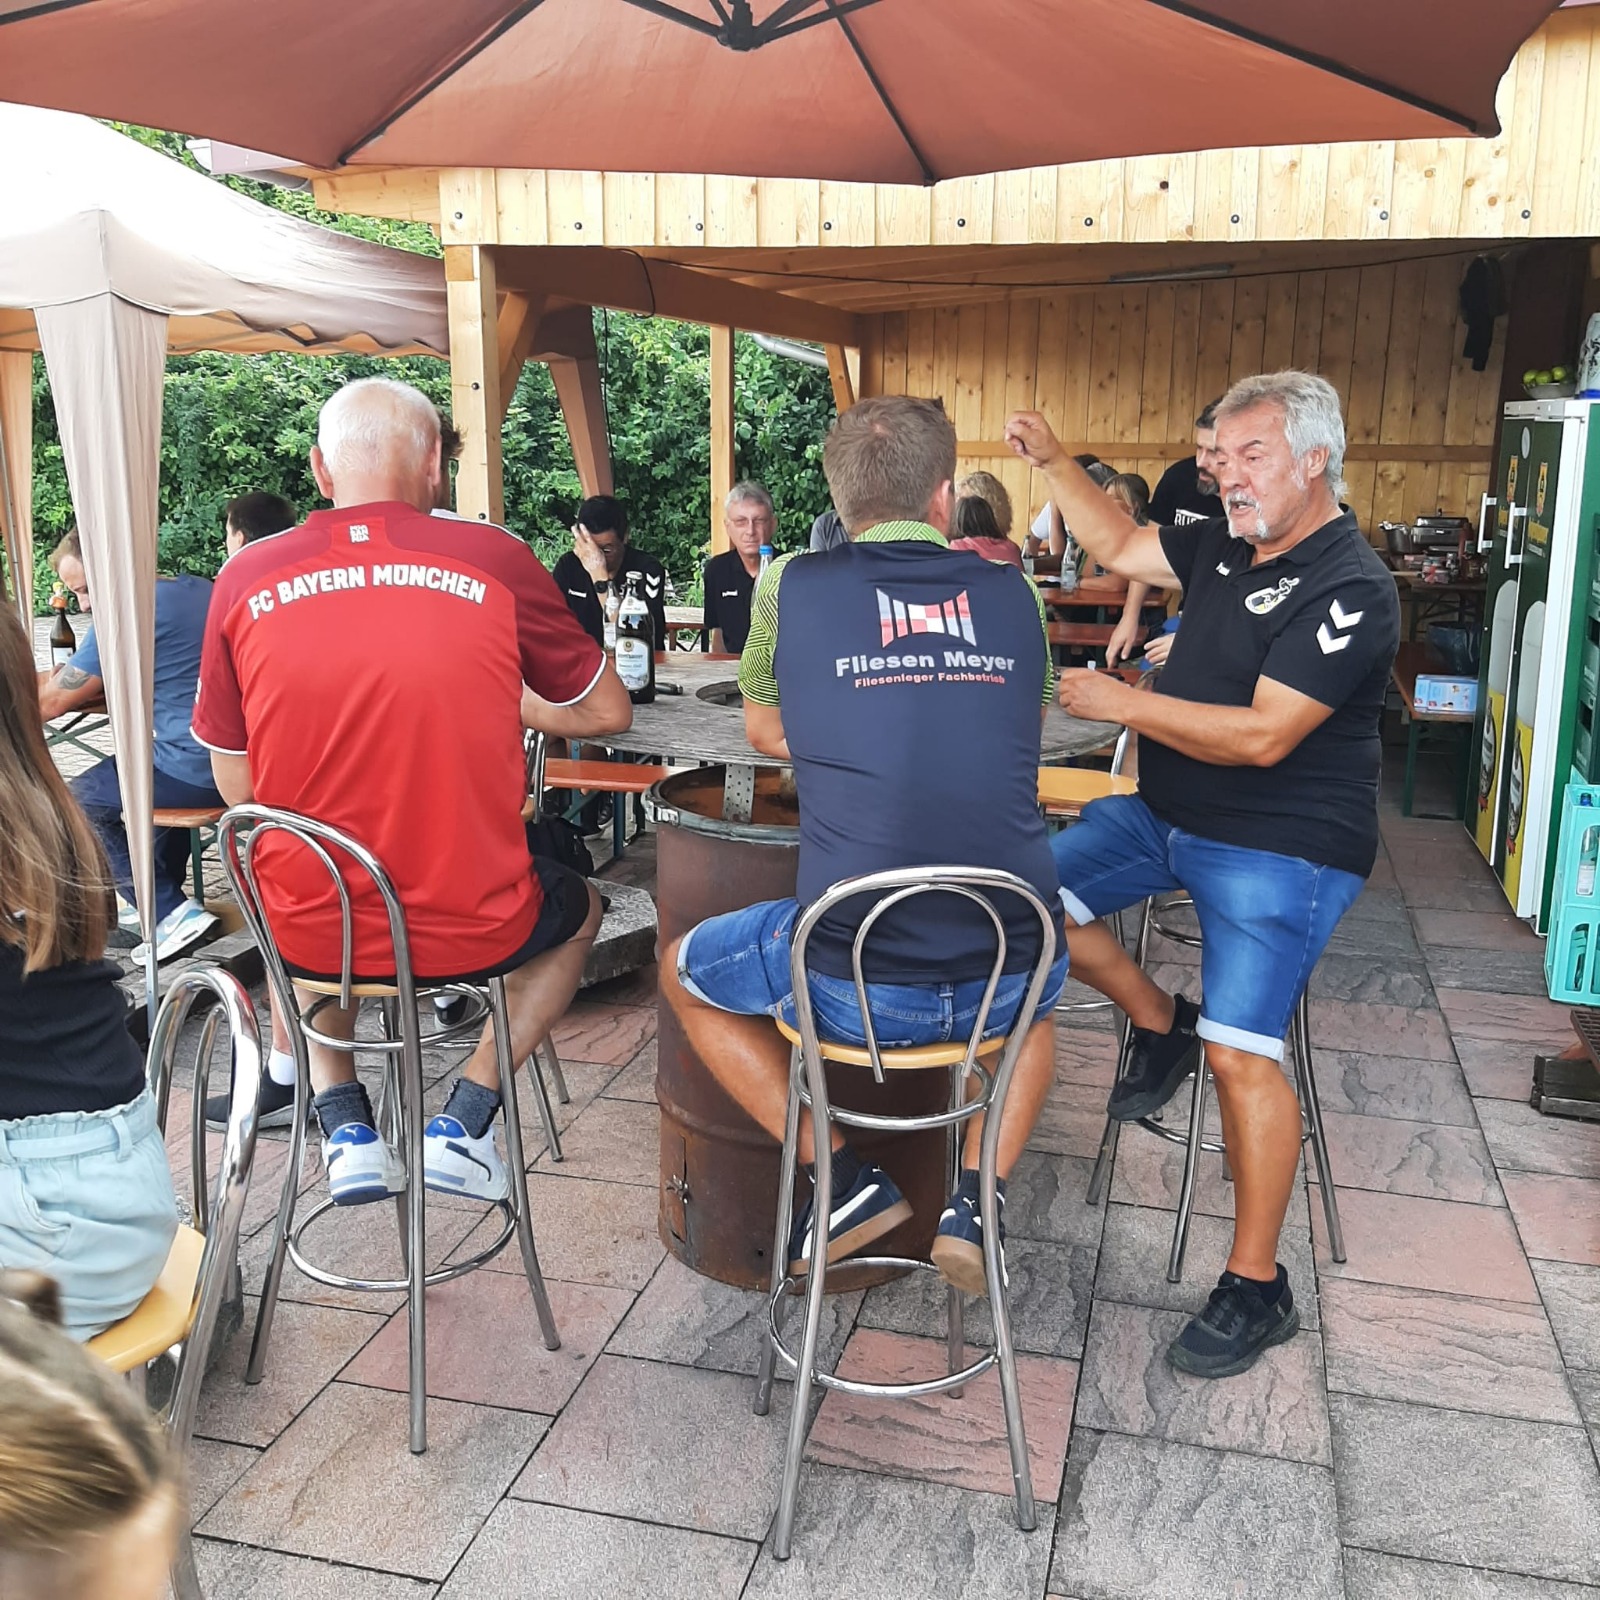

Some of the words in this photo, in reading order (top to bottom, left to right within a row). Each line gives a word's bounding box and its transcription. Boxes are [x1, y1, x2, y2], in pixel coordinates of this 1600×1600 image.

[247, 589, 275, 621] FC
[276, 565, 366, 605] BAYERN
[372, 564, 487, 605] MÜNCHEN
[835, 654, 935, 677] Fliesen
[943, 650, 1015, 672] Meyer
[854, 673, 934, 689] Fliesenleger
[938, 672, 1006, 684] Fachbetrieb
